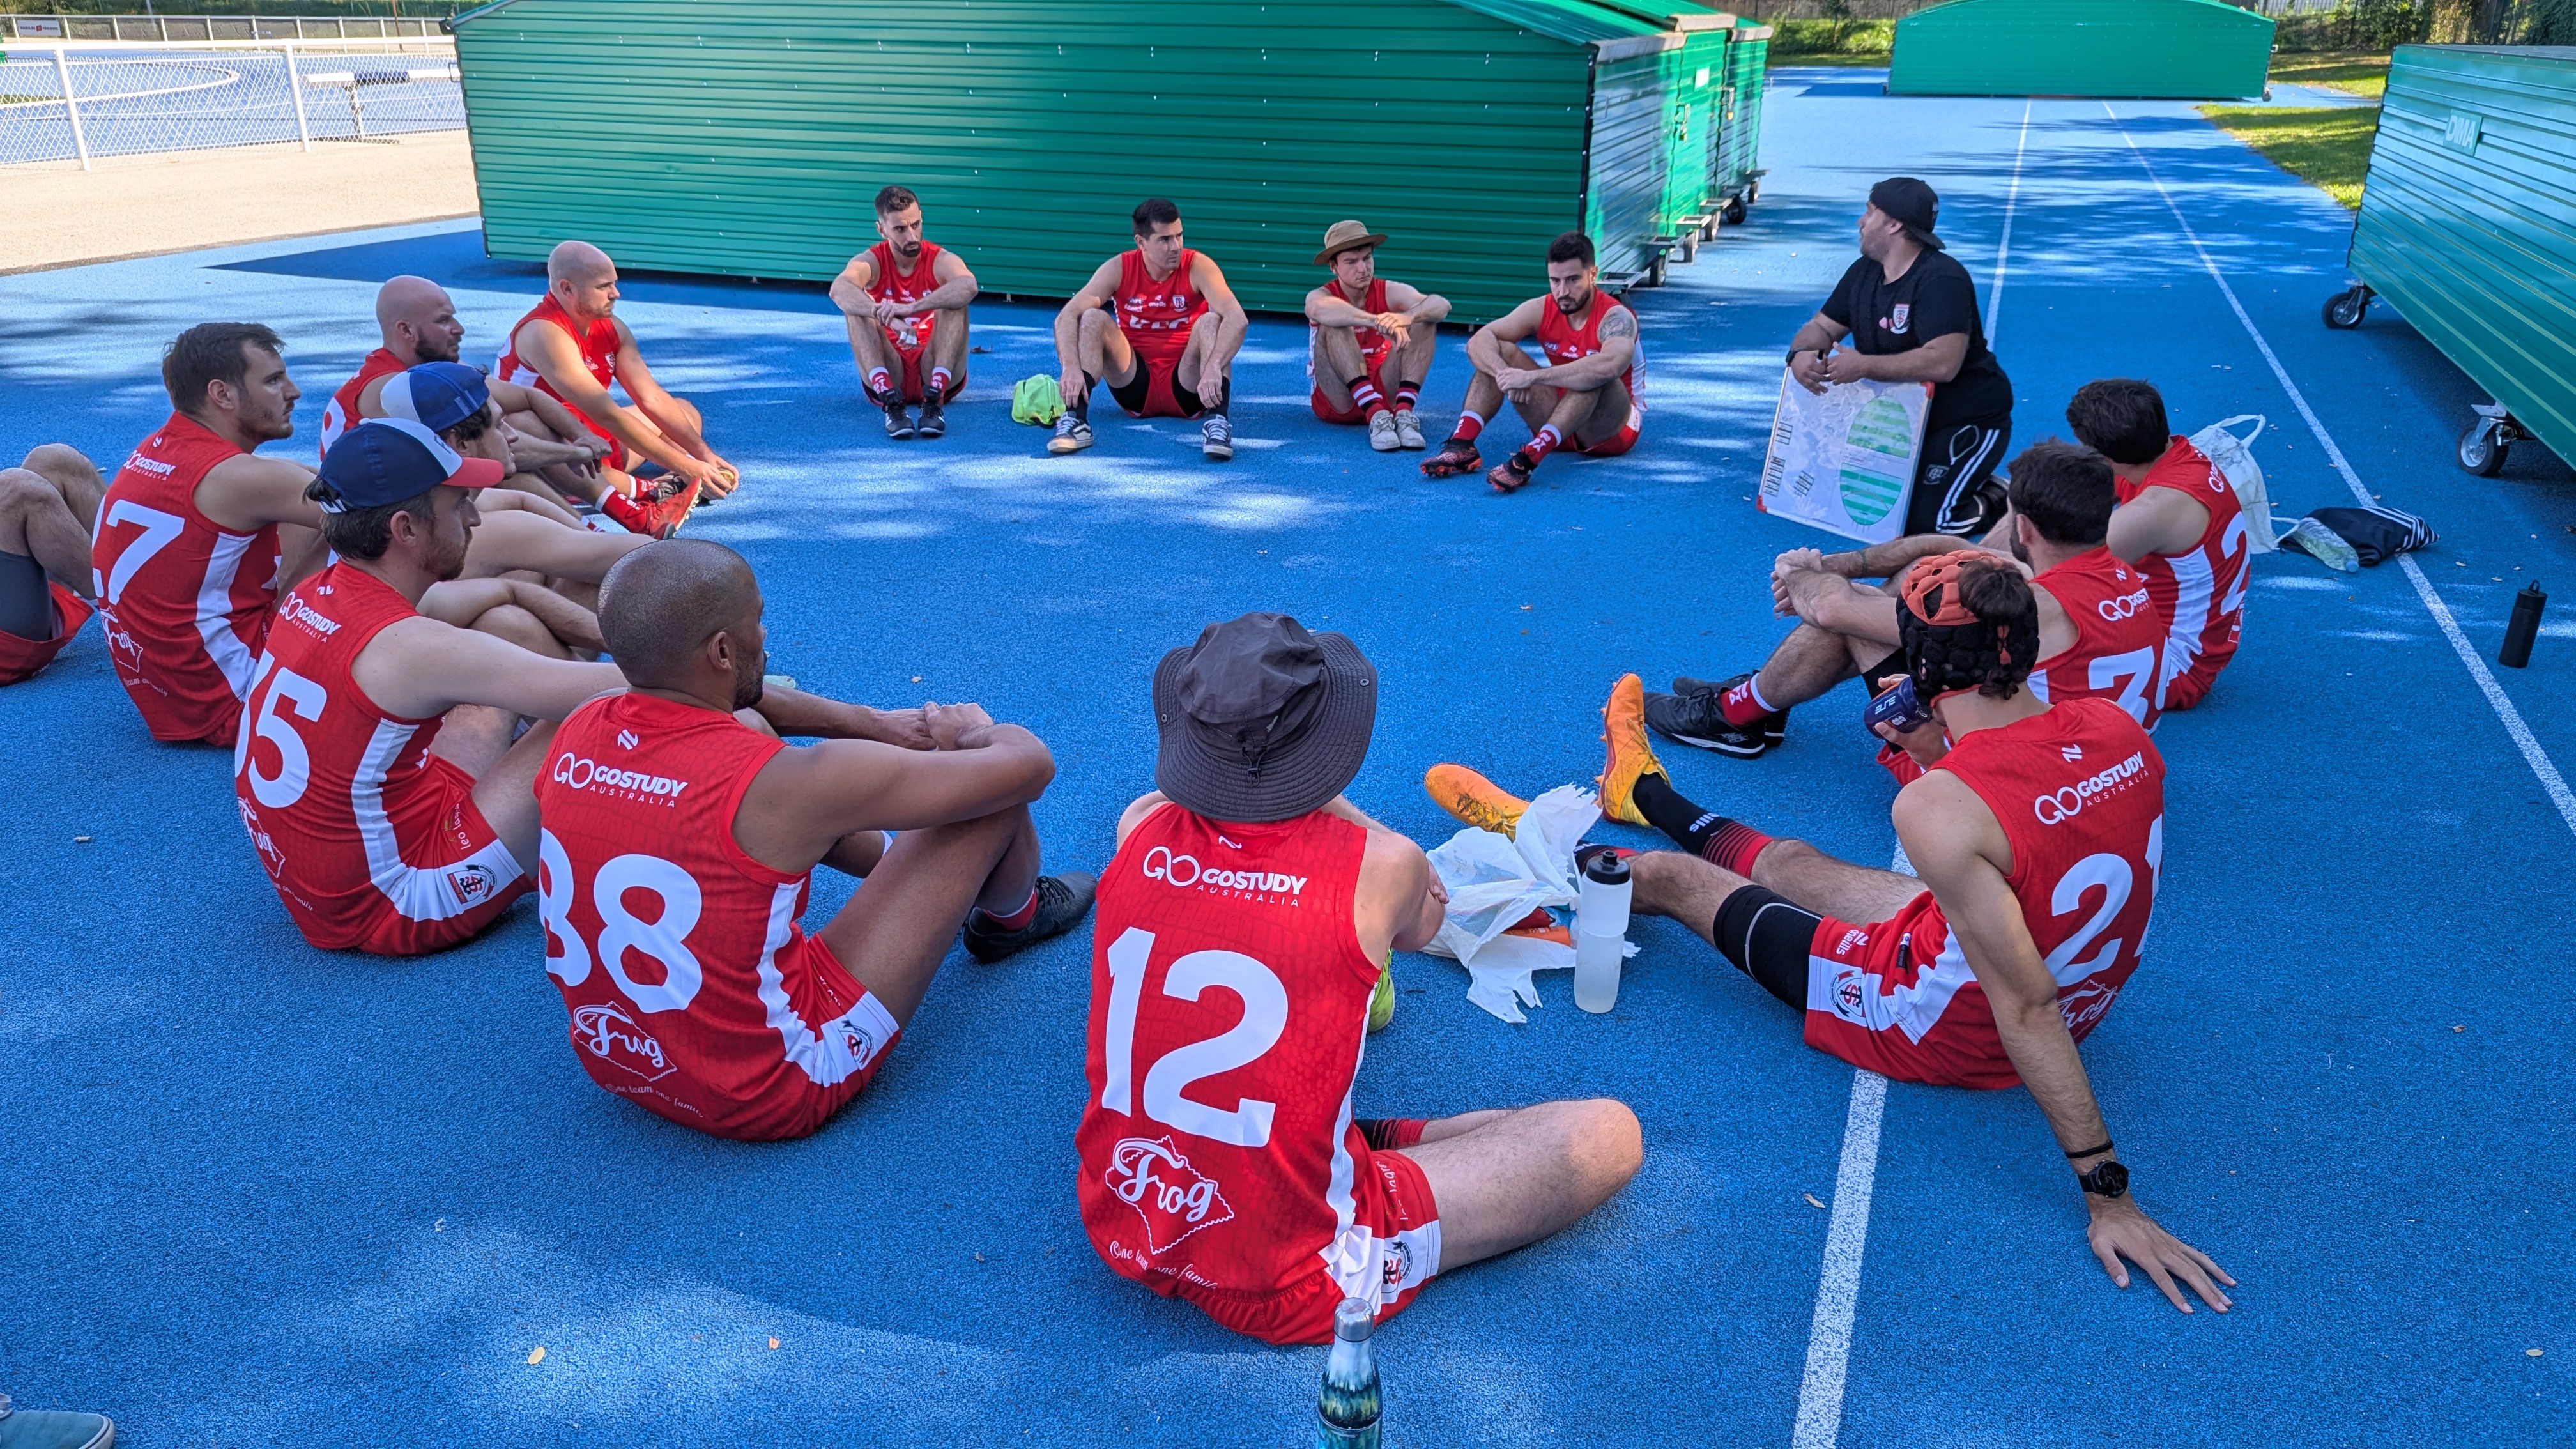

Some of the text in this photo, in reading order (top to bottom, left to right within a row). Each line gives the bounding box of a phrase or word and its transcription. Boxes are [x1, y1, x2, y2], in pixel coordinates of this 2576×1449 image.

[2446, 115, 2476, 149] DIMA
[130, 466, 167, 481] AUSTRALIA
[135, 457, 176, 475] GOSTUDY
[292, 618, 328, 643] AUSTRALIA
[297, 606, 342, 636] GOSTUDY
[594, 765, 688, 797] GOSTUDY
[2076, 751, 2145, 797] GOSTUDY
[589, 784, 675, 808] AUSTRALIA
[2087, 770, 2149, 807] AUSTRALIA
[458, 832, 472, 850] leo
[1197, 884, 1299, 907] AUSTRALIA
[1202, 868, 1308, 895] GOSTUDY
[576, 1008, 664, 1068] Frog
[1101, 926, 1289, 1147] 12
[1114, 1141, 1215, 1222] Frog
[1110, 1240, 1133, 1259] One
